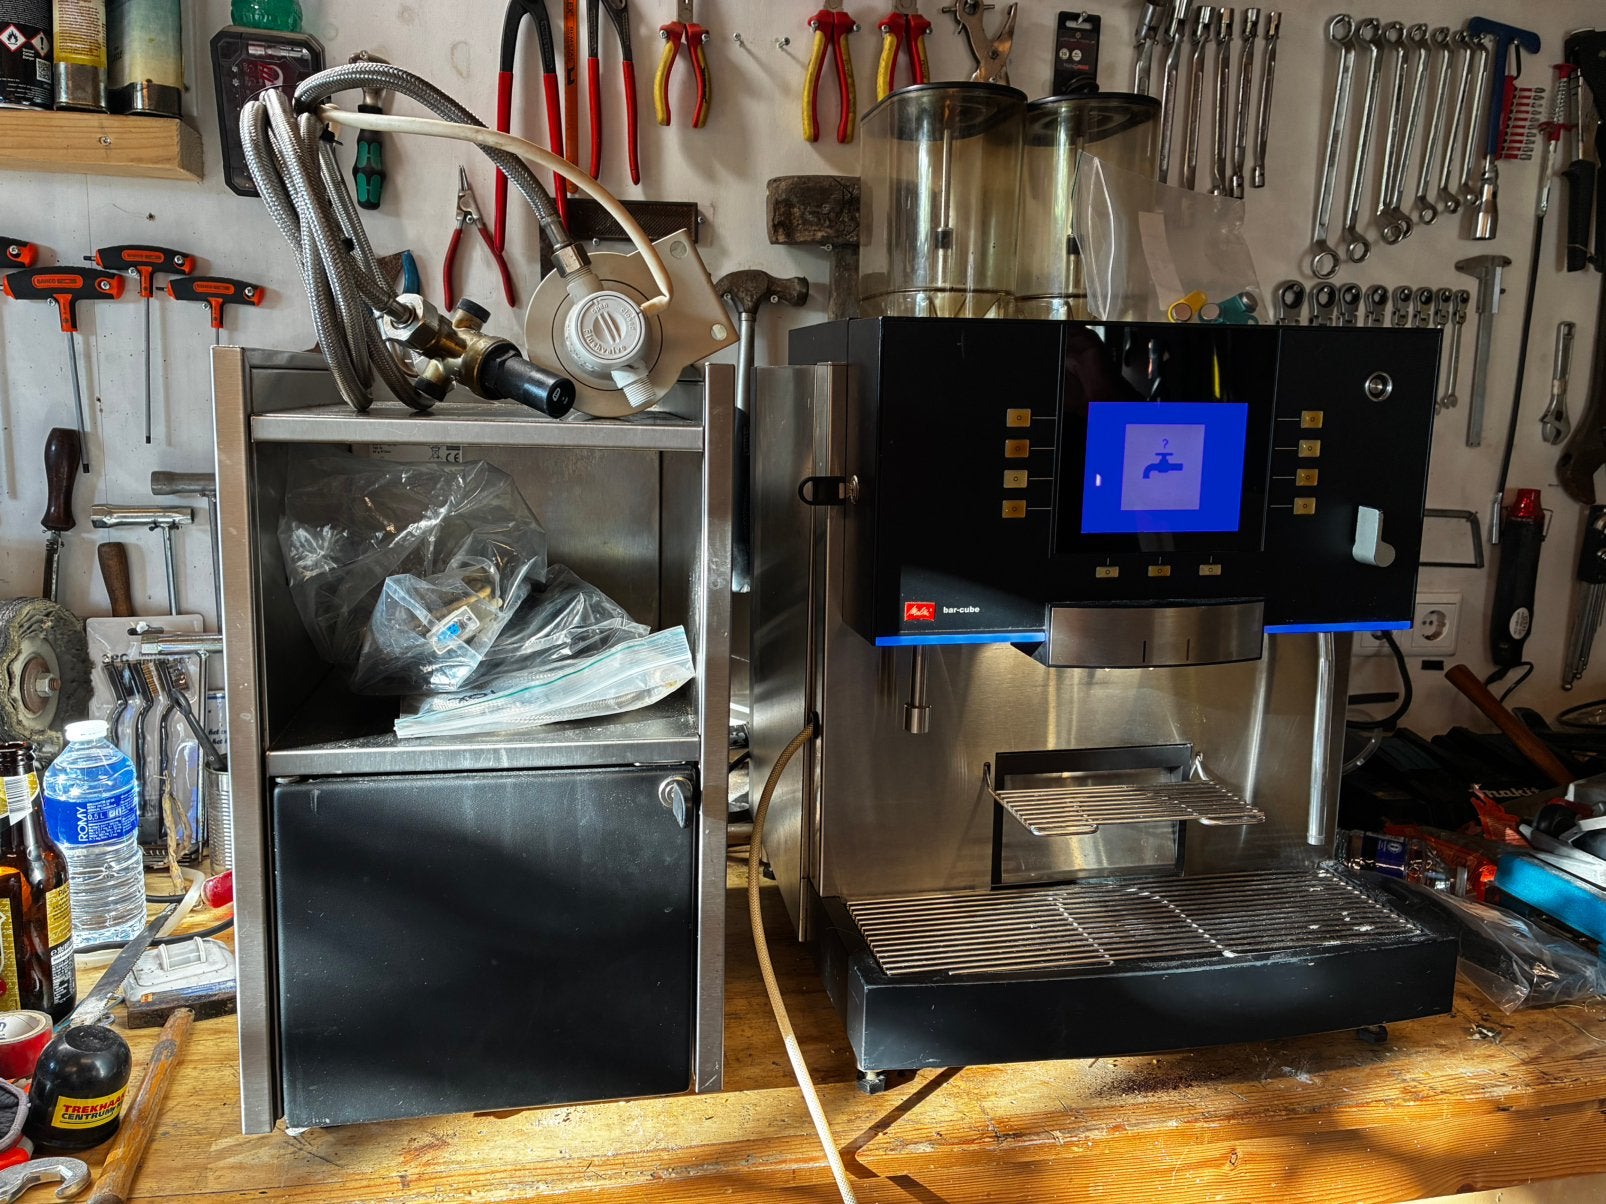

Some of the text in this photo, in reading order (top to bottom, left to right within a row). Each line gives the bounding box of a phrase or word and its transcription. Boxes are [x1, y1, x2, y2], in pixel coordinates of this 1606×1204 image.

[591, 302, 609, 314] open
[943, 605, 980, 614] bar-cube
[77, 806, 89, 842] ROMY
